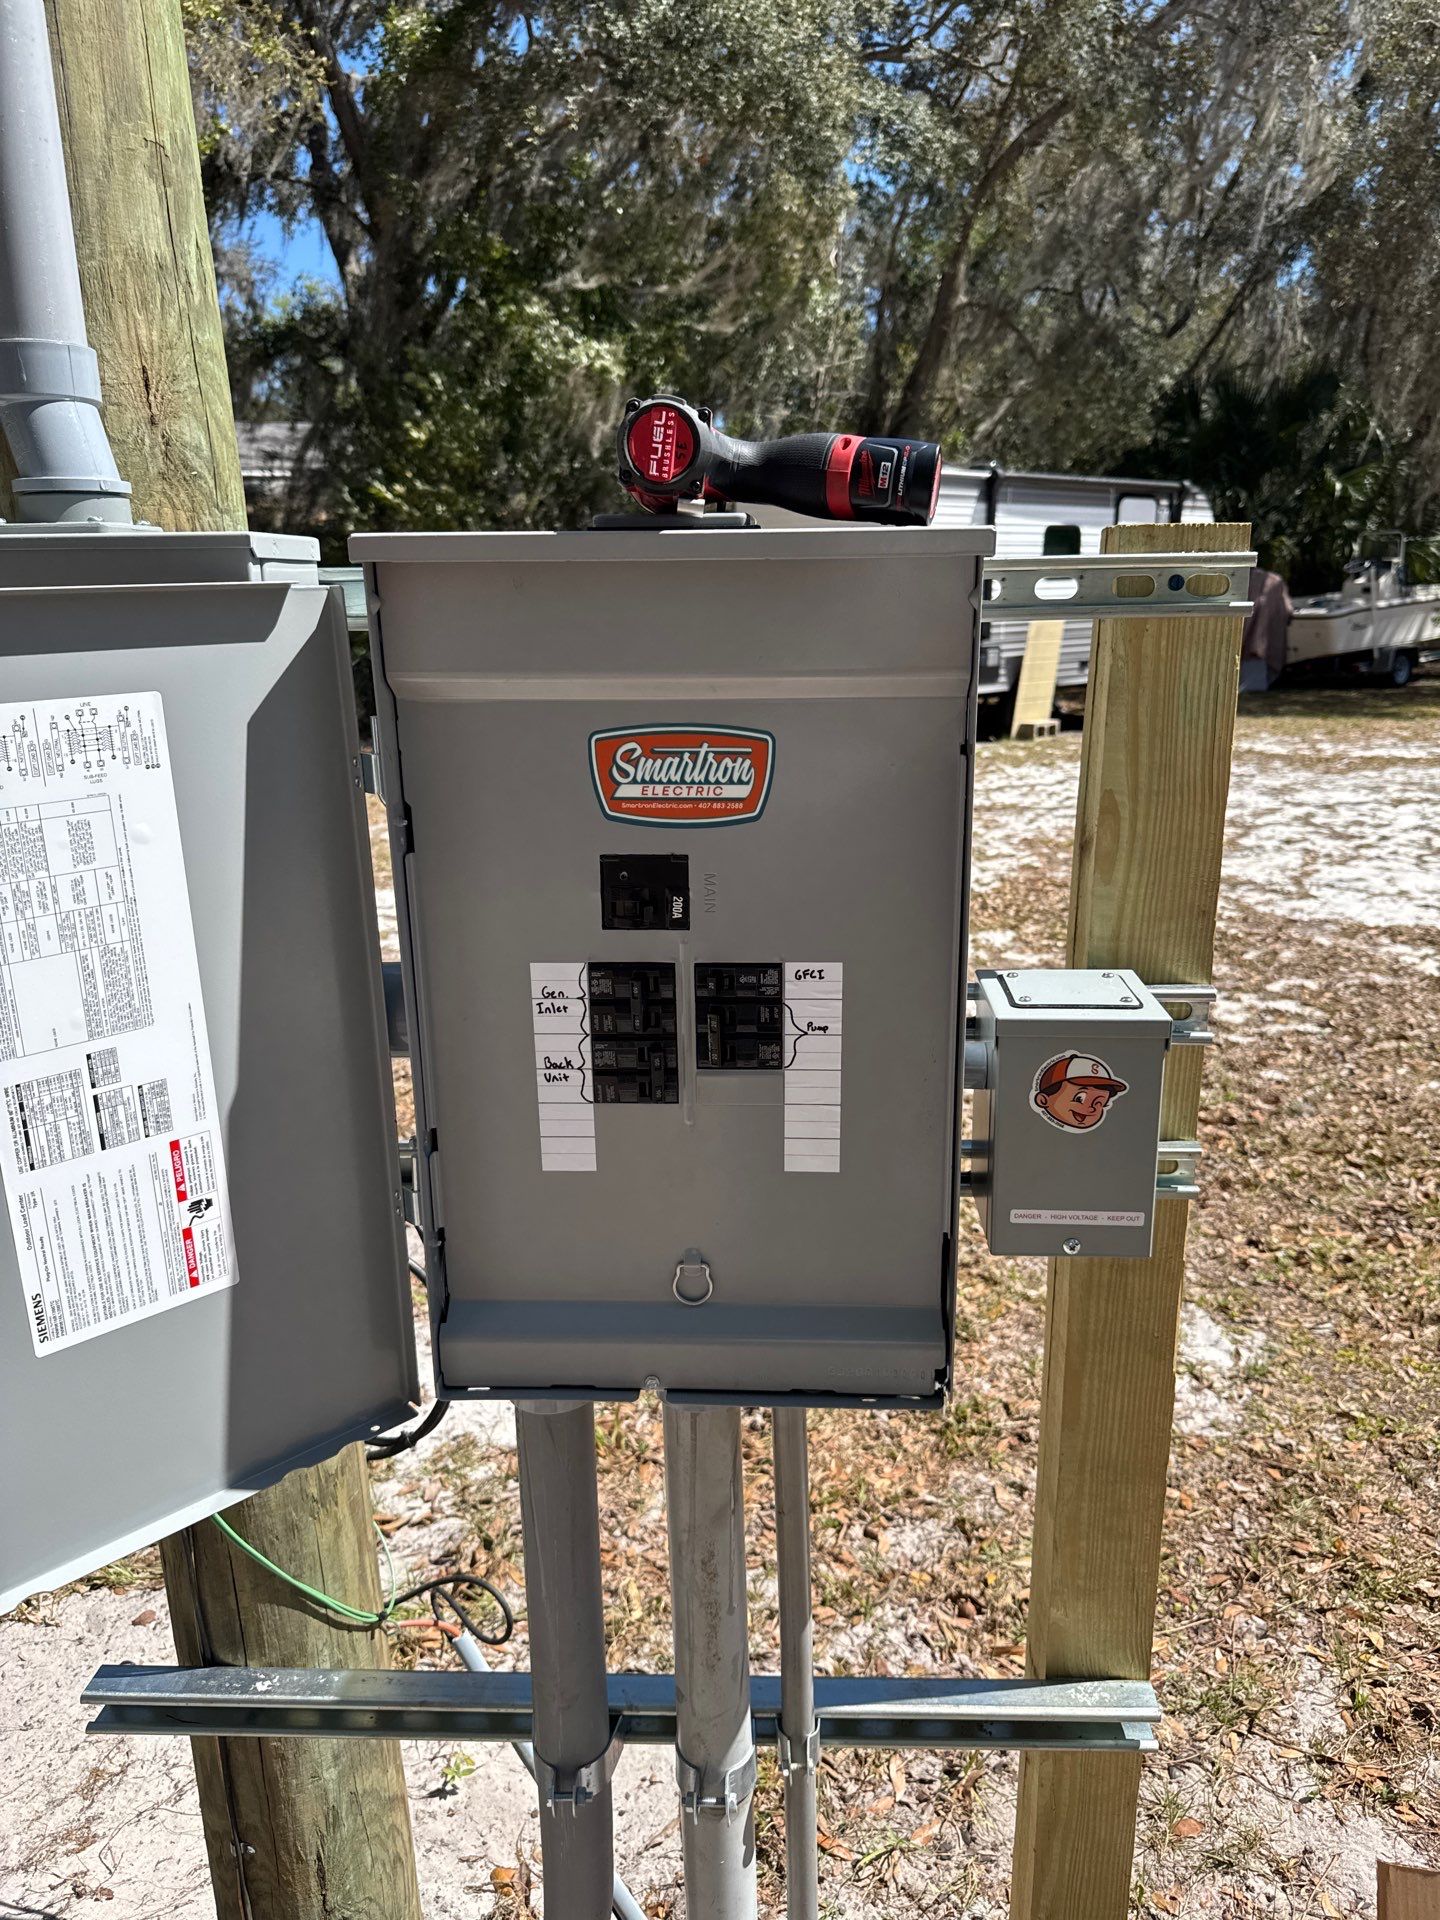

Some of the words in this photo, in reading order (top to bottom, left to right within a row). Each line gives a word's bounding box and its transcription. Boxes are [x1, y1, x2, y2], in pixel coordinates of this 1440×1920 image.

[649, 410, 667, 477] FUEL
[661, 411, 675, 478] BRUSHLESS
[879, 464, 889, 488] M12
[611, 741, 754, 784] Smartron
[641, 785, 724, 797] ELECTRIC
[704, 873, 717, 913] MAIN
[672, 896, 684, 919] 200A
[795, 968, 825, 980] GFCI
[542, 985, 569, 999] Gen.
[536, 1002, 569, 1014] Inlet
[806, 1021, 829, 1034] Pump
[544, 1056, 574, 1069] Back
[1091, 1063, 1100, 1075] S
[544, 1072, 570, 1083] Unit
[172, 1150, 184, 1183] PELIGRO
[185, 1238, 196, 1270] DANGER
[31, 1293, 49, 1343] SIEMENS
